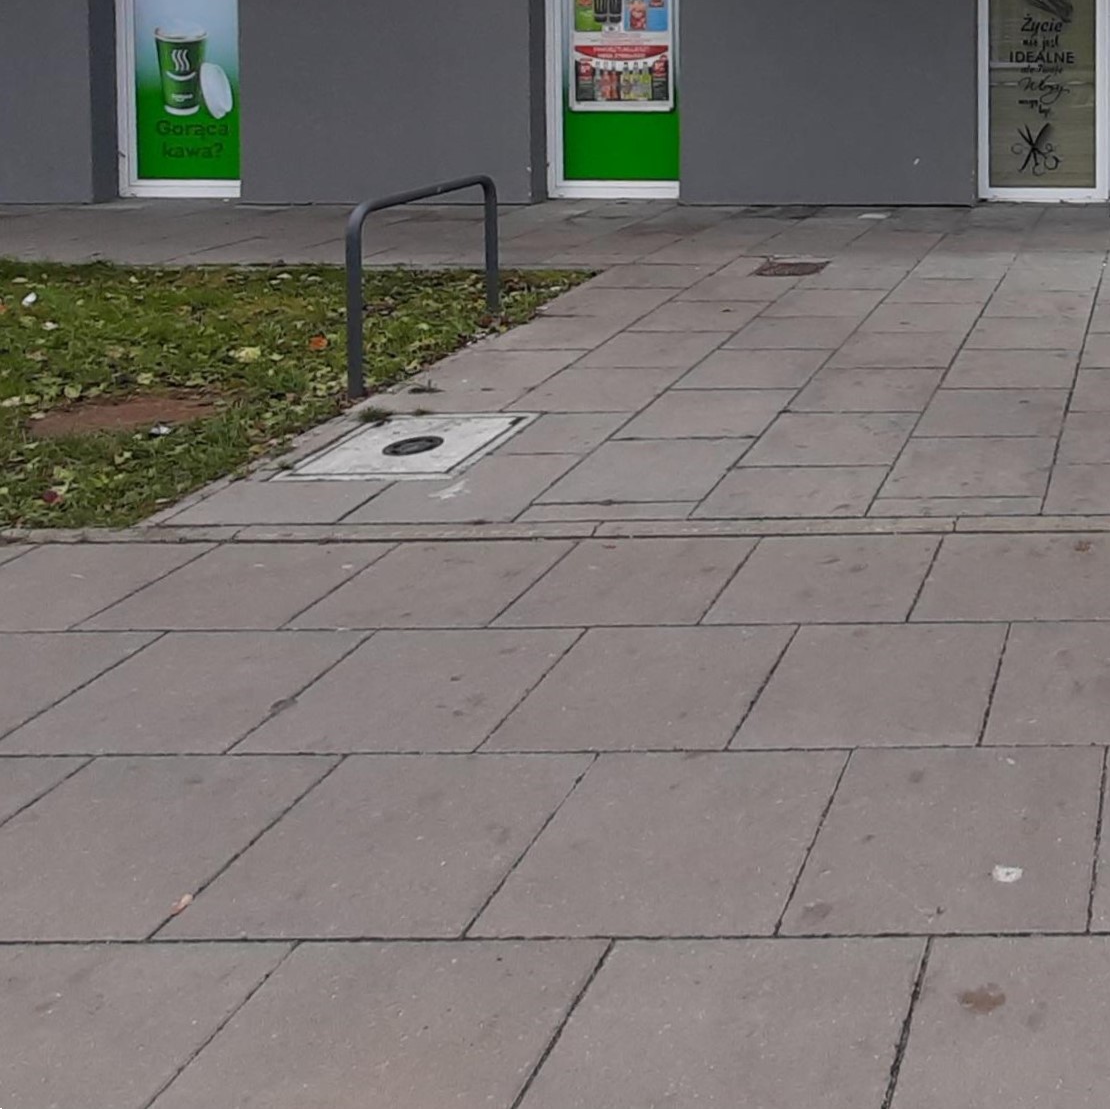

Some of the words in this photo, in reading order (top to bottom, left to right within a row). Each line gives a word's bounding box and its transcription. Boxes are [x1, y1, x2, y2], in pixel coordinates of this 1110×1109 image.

[1021, 13, 1064, 39] Życie
[1009, 51, 1076, 64] IDEALNE
[156, 120, 229, 140] Gorąca
[162, 141, 224, 159] kawa?
